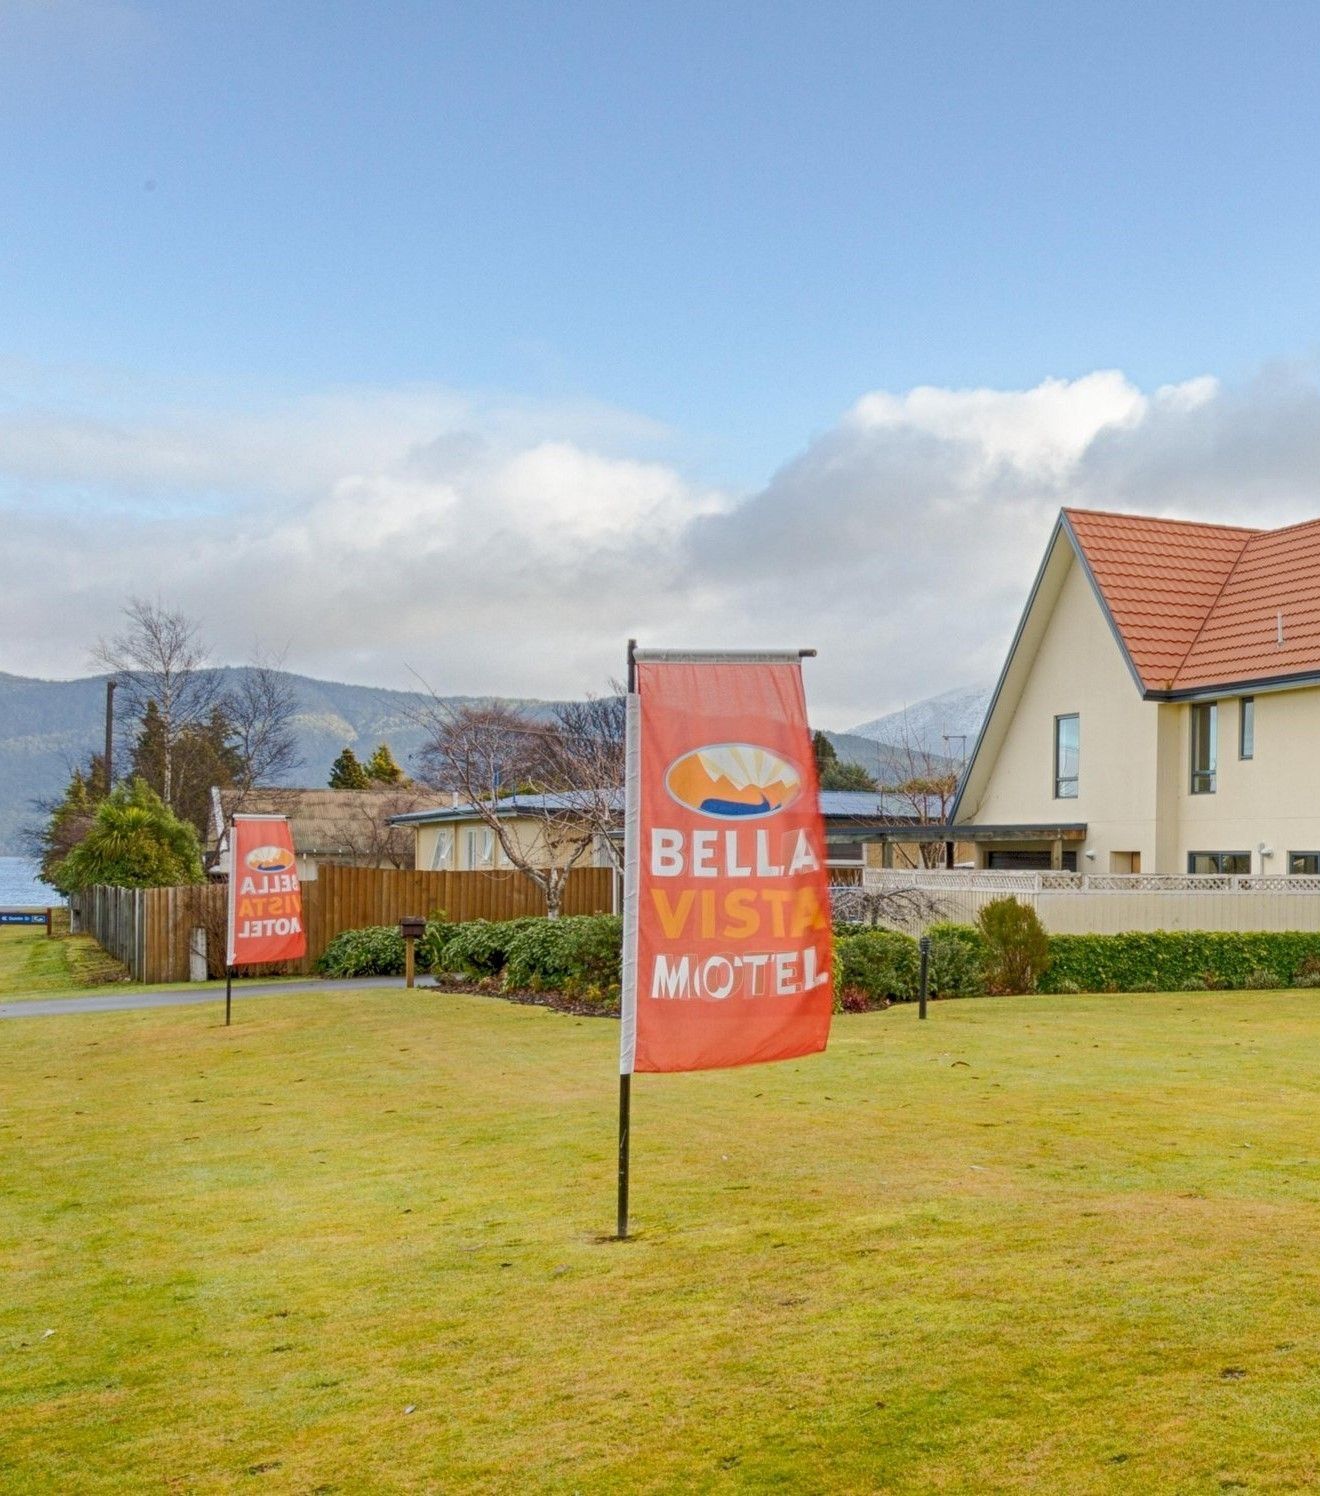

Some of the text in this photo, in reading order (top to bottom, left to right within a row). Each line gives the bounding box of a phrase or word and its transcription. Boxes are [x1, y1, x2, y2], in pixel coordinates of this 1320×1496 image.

[651, 828, 819, 877] BELLA
[652, 887, 828, 940] VISTA
[650, 945, 829, 1000] MOTEL
